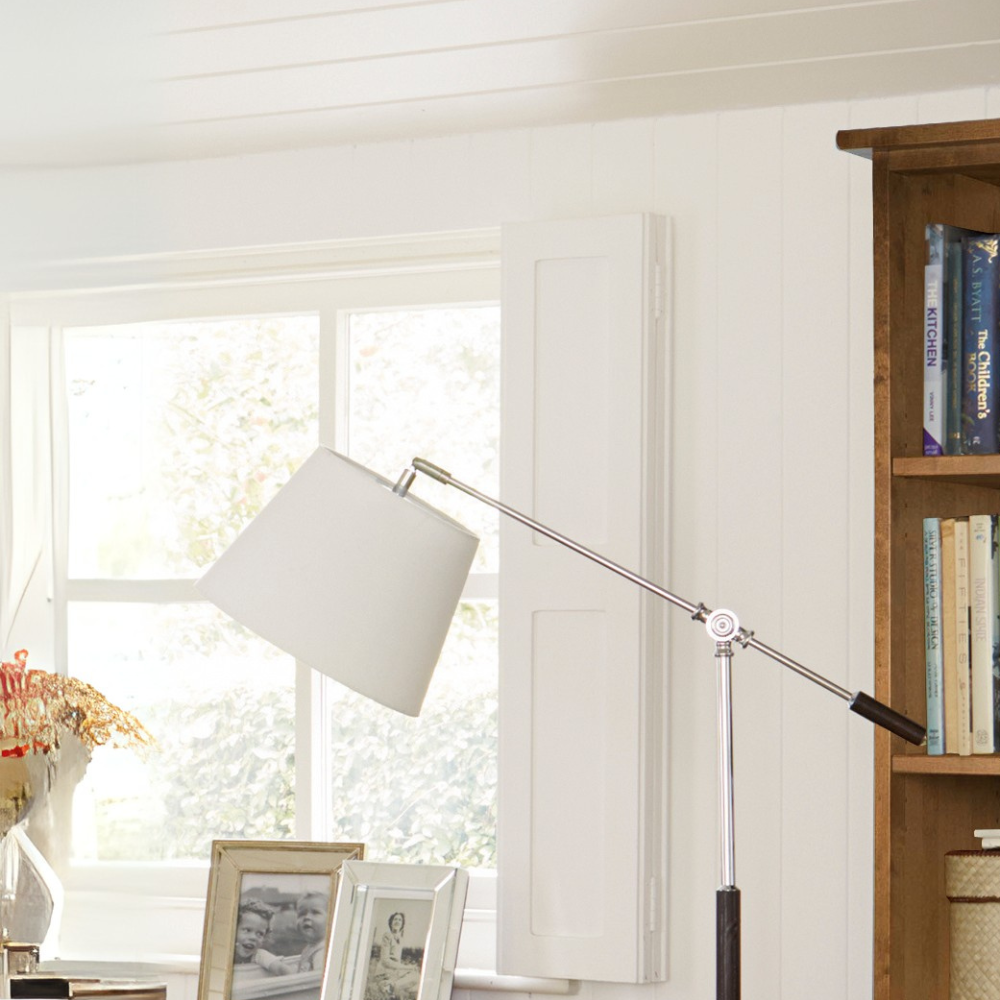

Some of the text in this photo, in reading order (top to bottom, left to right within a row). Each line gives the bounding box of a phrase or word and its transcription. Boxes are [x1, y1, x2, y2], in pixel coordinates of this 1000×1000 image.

[926, 280, 938, 367] THE KITCHEN
[971, 254, 982, 322] A.S. BYATT
[966, 352, 977, 393] BOOK
[976, 329, 991, 419] The Children's
[929, 530, 940, 649] SILVER STUDIO DESIGN
[975, 578, 987, 642] INDIAN STYLE
